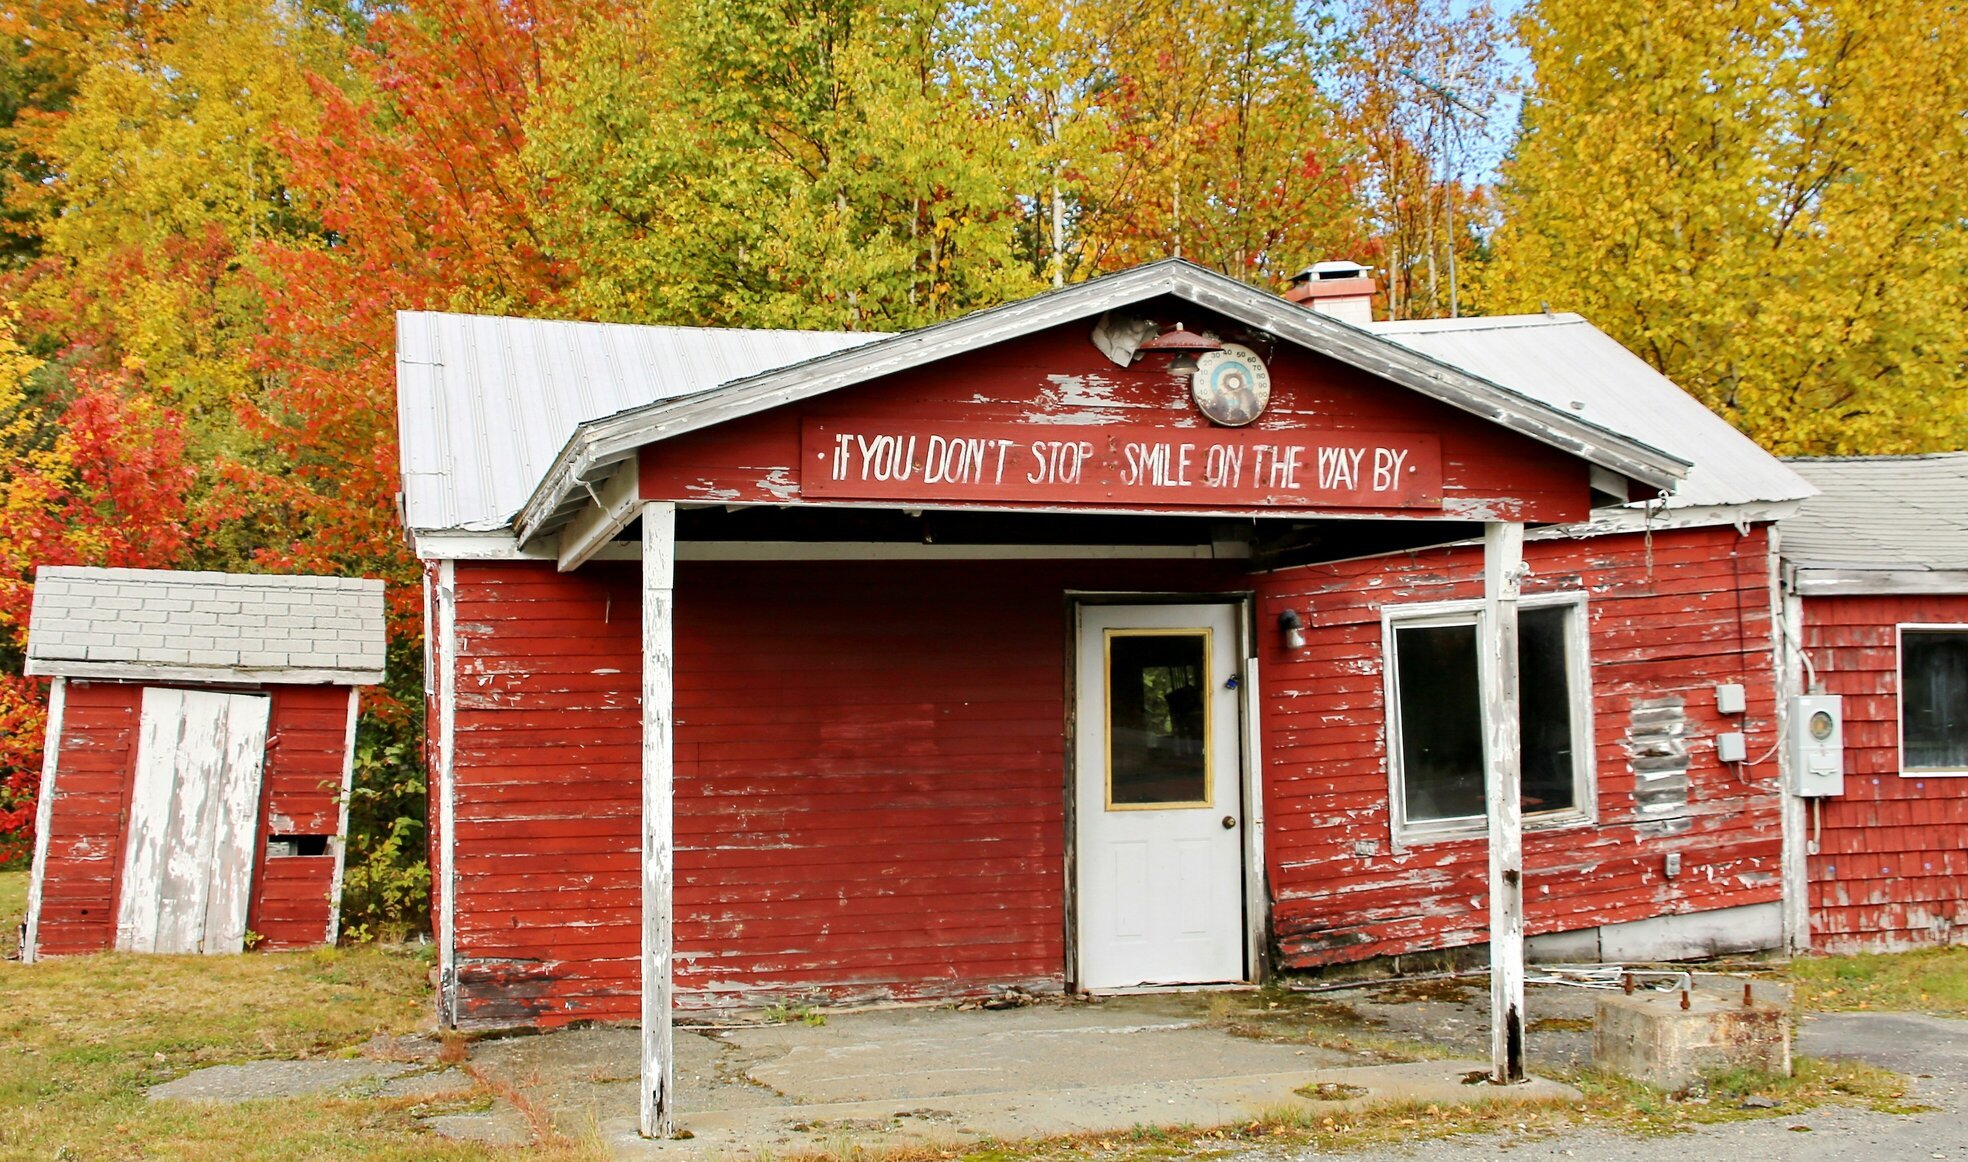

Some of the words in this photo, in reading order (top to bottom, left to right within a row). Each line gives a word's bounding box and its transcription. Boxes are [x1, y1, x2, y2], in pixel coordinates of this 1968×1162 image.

[857, 434, 917, 482] YOU
[923, 435, 1017, 485] DON'T
[1026, 440, 1095, 485] STOP
[1206, 444, 1245, 488] ON
[1252, 444, 1306, 489] THE
[1317, 446, 1367, 491] WAY
[1373, 447, 1409, 491] BY
